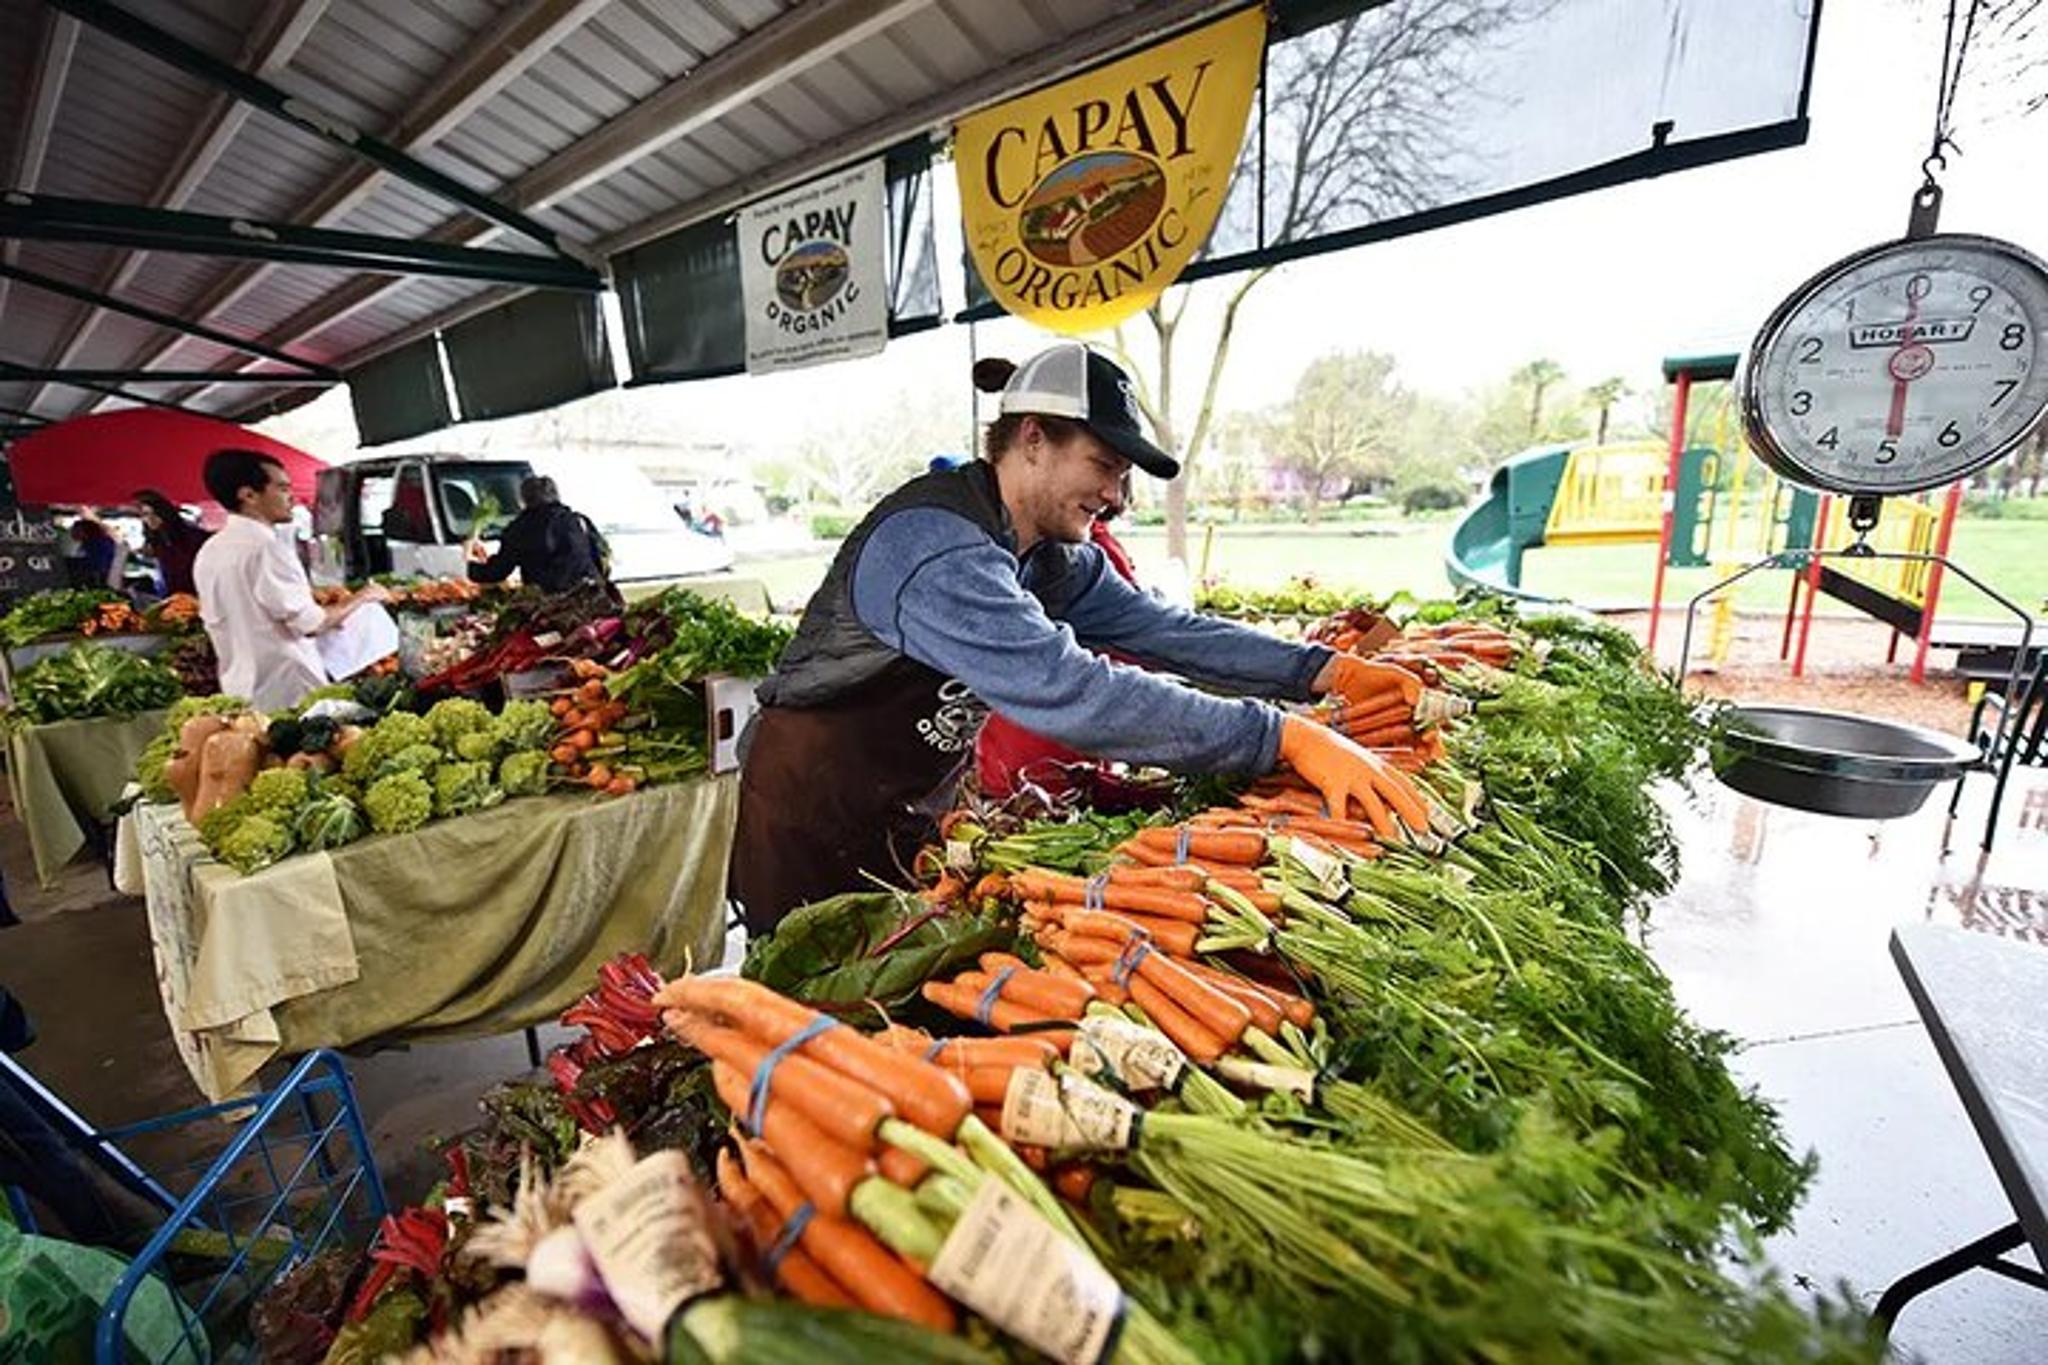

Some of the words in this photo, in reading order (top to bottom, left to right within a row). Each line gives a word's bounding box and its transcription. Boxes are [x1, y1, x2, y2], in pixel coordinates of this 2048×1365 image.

[986, 60, 1213, 209] CAPAY
[761, 201, 857, 267] CAPAY
[995, 207, 1188, 311] ORGANIC
[1906, 274, 1931, 301] 0
[1969, 286, 1992, 313] 9
[765, 281, 860, 334] ORGANIC
[2000, 324, 2025, 350] 8
[1800, 338, 1823, 364] 2
[1791, 392, 1812, 415] 3
[1990, 380, 2018, 408] 7
[1817, 427, 1839, 450] 4
[1938, 421, 1961, 447] 6
[1876, 440, 1897, 464] 5
